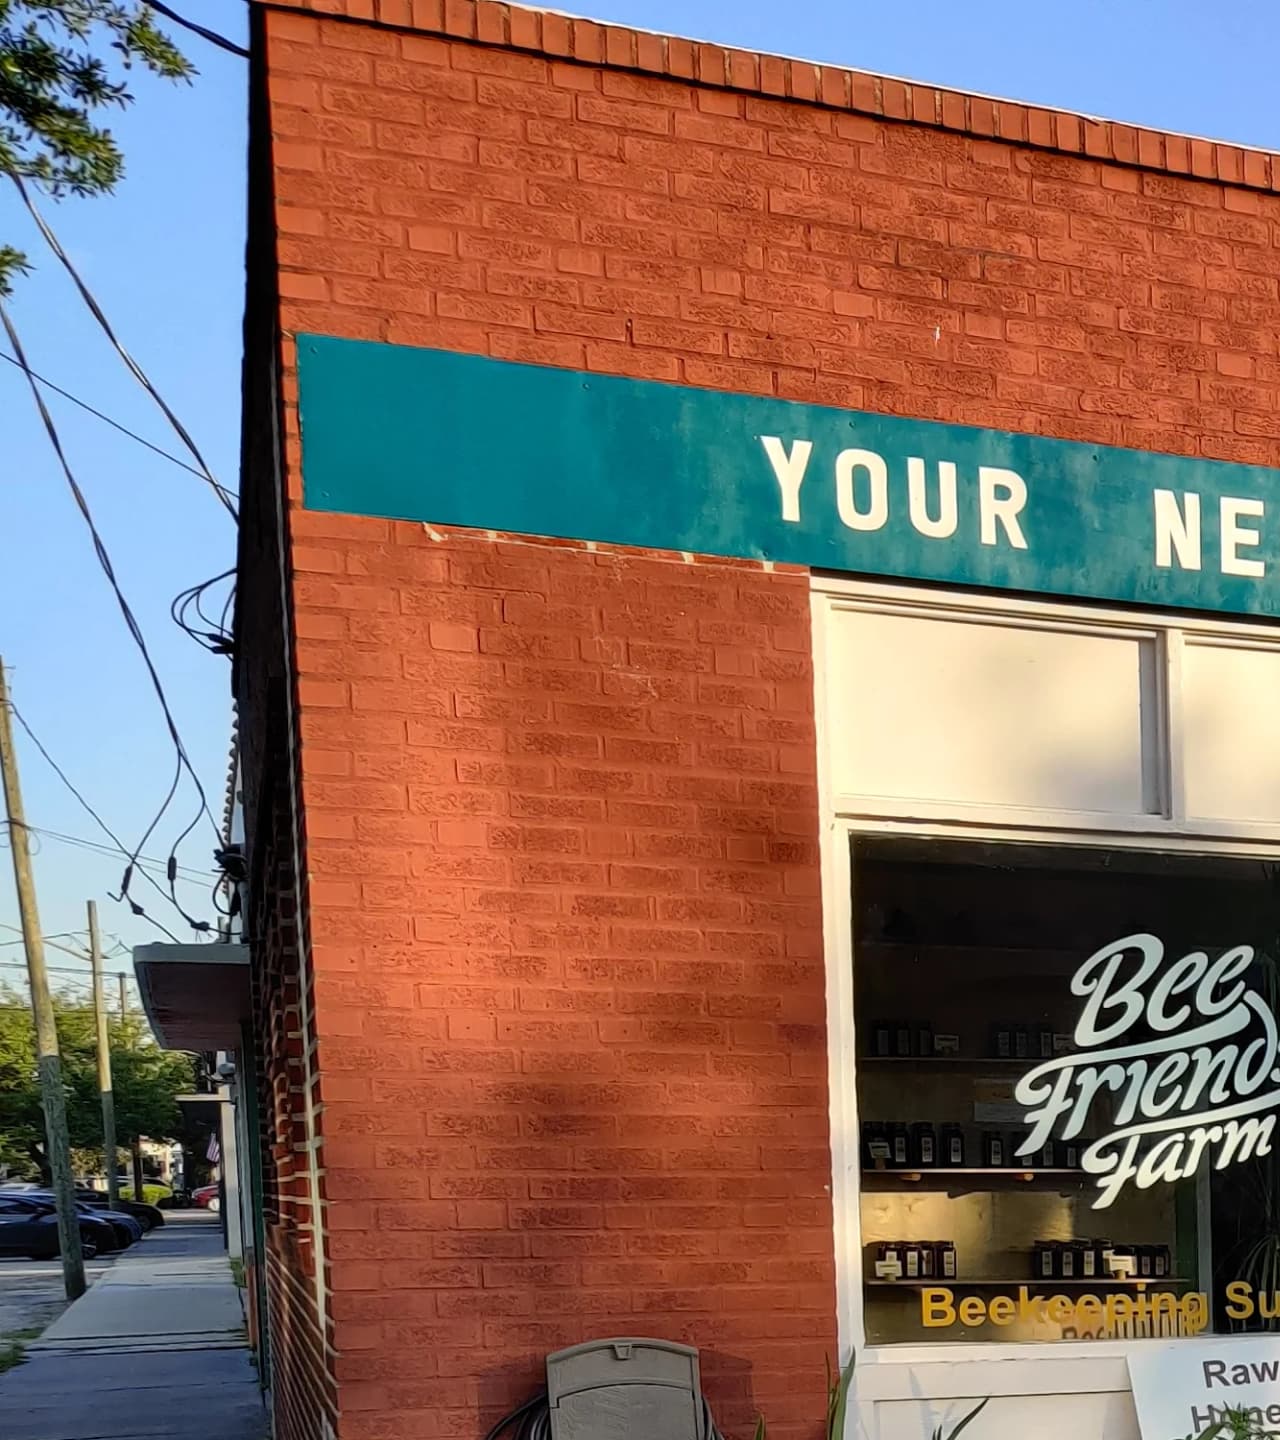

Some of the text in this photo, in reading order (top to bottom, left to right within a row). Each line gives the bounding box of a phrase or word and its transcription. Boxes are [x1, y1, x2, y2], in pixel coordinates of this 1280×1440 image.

[760, 436, 1029, 550] YOUR
[1070, 933, 1255, 1047] Bee
[1081, 1110, 1277, 1210] Farm
[921, 1283, 1208, 1336] Beekeeping
[1202, 1360, 1279, 1388] Raw
